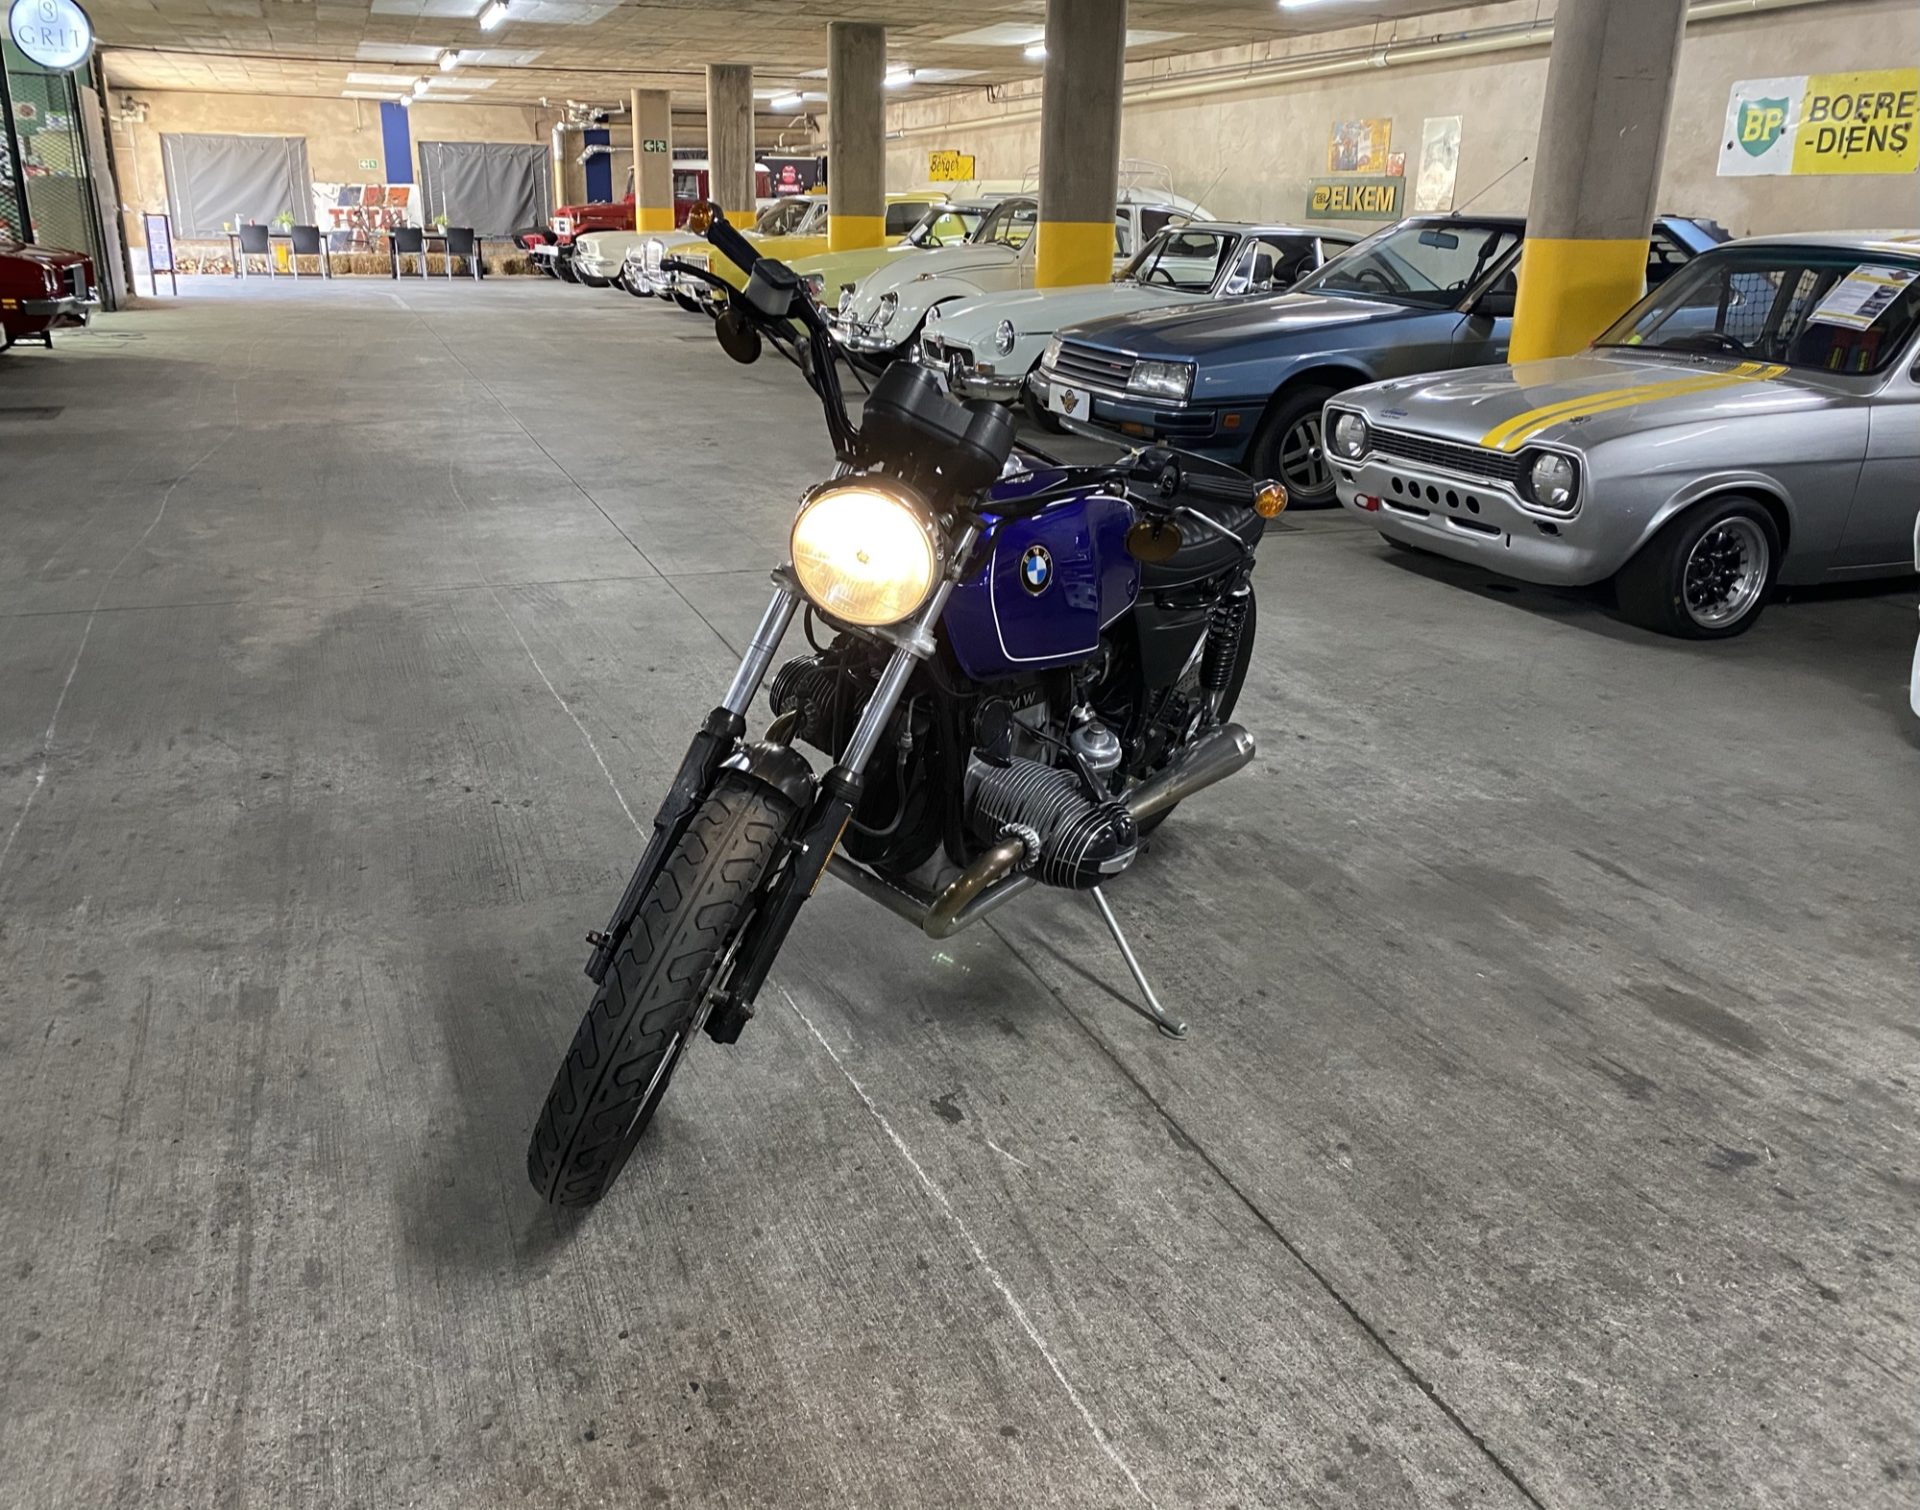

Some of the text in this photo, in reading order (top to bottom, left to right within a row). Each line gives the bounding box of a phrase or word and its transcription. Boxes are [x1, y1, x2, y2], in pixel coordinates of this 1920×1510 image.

[18, 25, 82, 48] GRIT
[1808, 90, 1918, 122] BOERE
[1741, 107, 1784, 142] BP
[1330, 184, 1398, 212] ELKEM
[1023, 547, 1049, 564] BMW
[1010, 691, 1036, 710] MW
